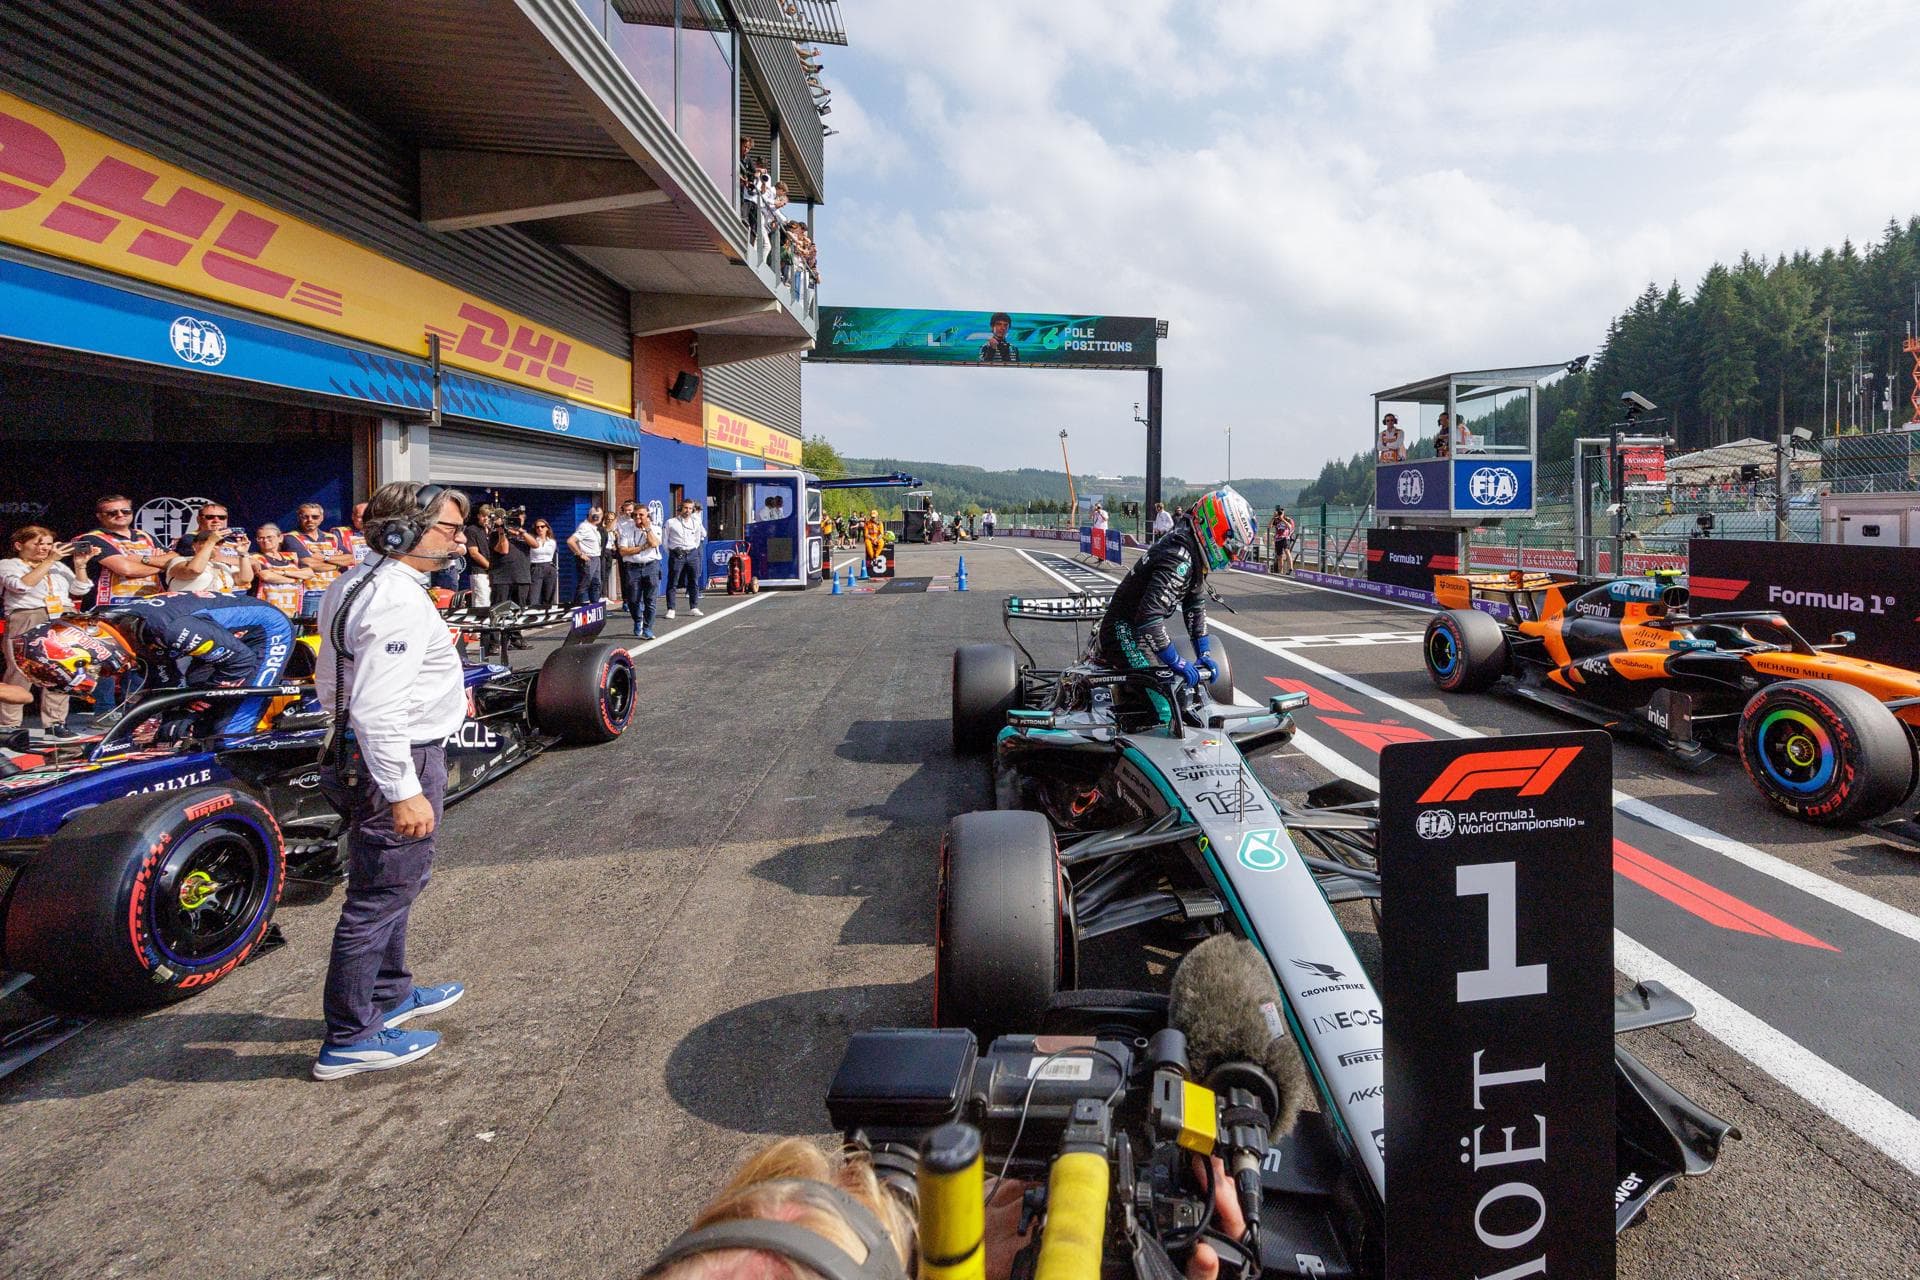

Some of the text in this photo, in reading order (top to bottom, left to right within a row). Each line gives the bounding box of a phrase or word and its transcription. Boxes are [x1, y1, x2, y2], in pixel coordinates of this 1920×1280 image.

[455, 302, 577, 385] DHL
[1043, 327, 1060, 350] 6
[1064, 327, 1095, 339] POLE
[1064, 340, 1133, 352] POSITIONS
[716, 413, 750, 449] DHL
[768, 432, 791, 460] DHL
[872, 554, 887, 574] 3
[1389, 552, 1415, 565] Formula
[1398, 589, 1426, 600] LAS VEGAS
[1768, 585, 1864, 612] Formula
[1022, 597, 1112, 615] PETRON
[1575, 598, 1612, 618] Gemini
[573, 608, 596, 629] Mobil
[1757, 660, 1834, 681] RICHARD MILLE
[1648, 704, 1669, 729] intel
[442, 721, 497, 748] ACLE
[1176, 766, 1249, 781] Syntium
[183, 793, 235, 822] PIRELLI
[1195, 789, 1265, 815] 12
[1458, 808, 1536, 824] FIA Formula 1
[1458, 822, 1493, 835] World
[1495, 816, 1577, 833] Championship
[1456, 861, 1548, 1002] 1
[1301, 983, 1366, 998] CROWDSTRIKE
[1312, 1009, 1384, 1035] INEOS
[1337, 1047, 1384, 1067] PIREL
